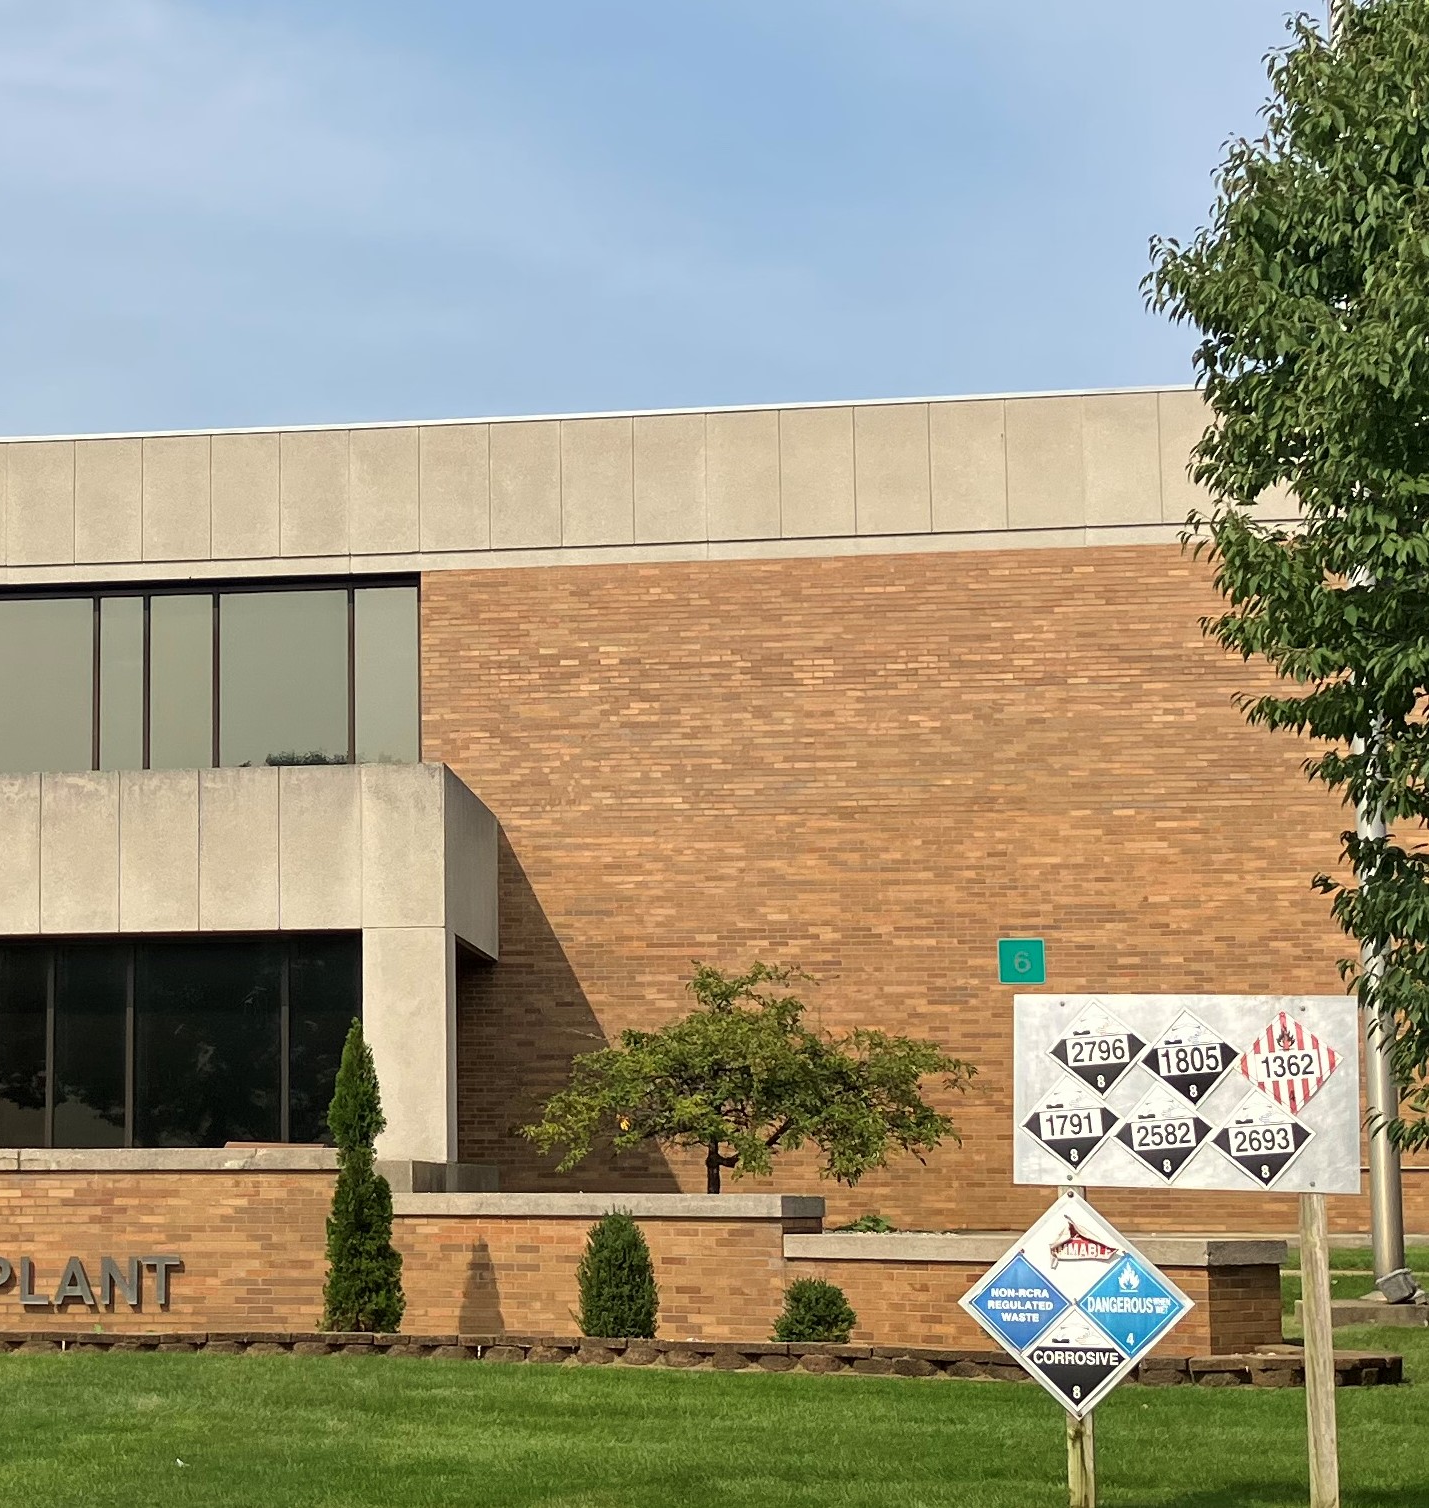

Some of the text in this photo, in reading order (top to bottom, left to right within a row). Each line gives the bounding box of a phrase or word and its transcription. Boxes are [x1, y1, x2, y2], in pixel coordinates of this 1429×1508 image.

[1014, 950, 1031, 973] 6
[1071, 1038, 1125, 1064] 2796
[1160, 1045, 1220, 1074] 1805
[1261, 1053, 1315, 1079] 1362
[1097, 1074, 1106, 1088] 8
[1189, 1084, 1198, 1098] 8
[1045, 1111, 1093, 1137] 1791
[1136, 1121, 1192, 1148] 2582
[1233, 1127, 1291, 1153] 2693
[1070, 1148, 1079, 1162] 8
[1162, 1158, 1172, 1173] 8
[1260, 1164, 1270, 1178] 8
[990, 1287, 1049, 1298] NON-RCRA
[987, 1299, 1054, 1311] REGULATED
[1087, 1296, 1154, 1314] DANGEROUS
[1001, 1312, 1040, 1323] WASTE
[1126, 1332, 1135, 1346] 4
[1033, 1350, 1119, 1366] CORROSIVE
[1072, 1385, 1081, 1399] 8
